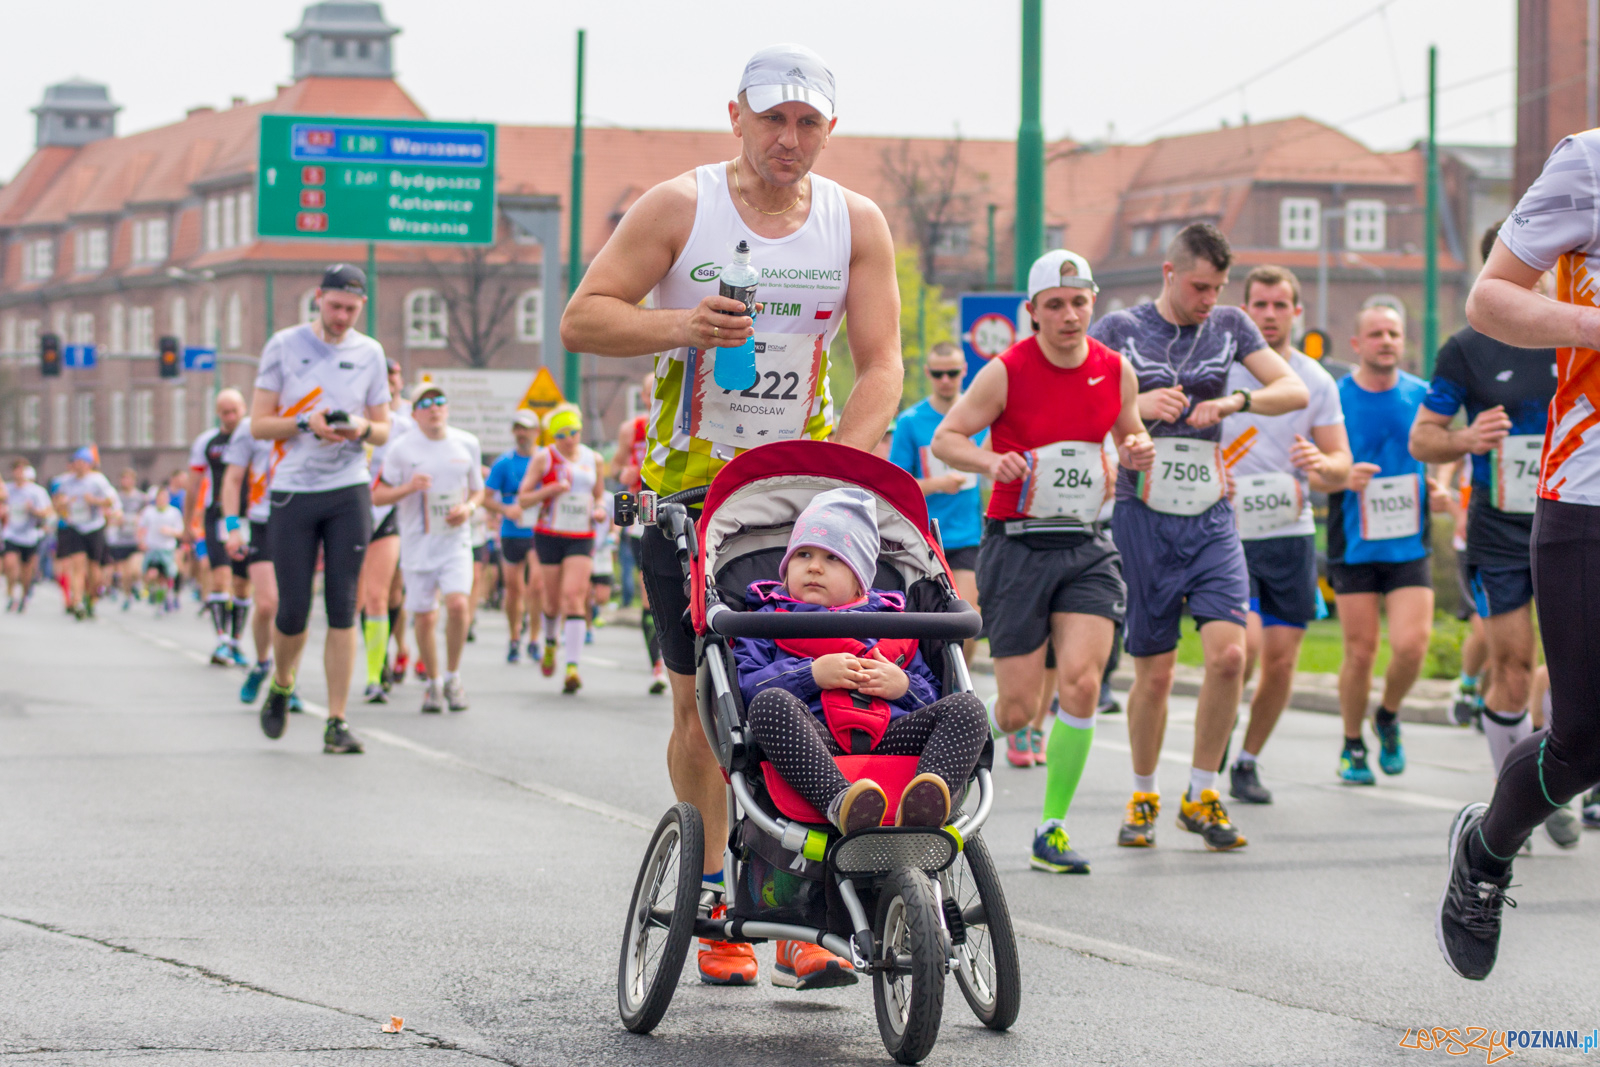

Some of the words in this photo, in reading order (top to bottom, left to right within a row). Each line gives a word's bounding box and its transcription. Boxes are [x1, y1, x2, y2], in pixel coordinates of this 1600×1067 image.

[391, 137, 482, 158] Warszawa
[389, 194, 473, 213] Katowice
[697, 269, 715, 277] SGB
[761, 268, 841, 281] RAKONIEWICE
[770, 302, 801, 317] TEAM
[722, 371, 800, 400] 222
[729, 403, 786, 416] RADOSŁAW
[1053, 468, 1093, 488] 284
[1161, 461, 1211, 483] 7508
[1243, 493, 1291, 513] 5504
